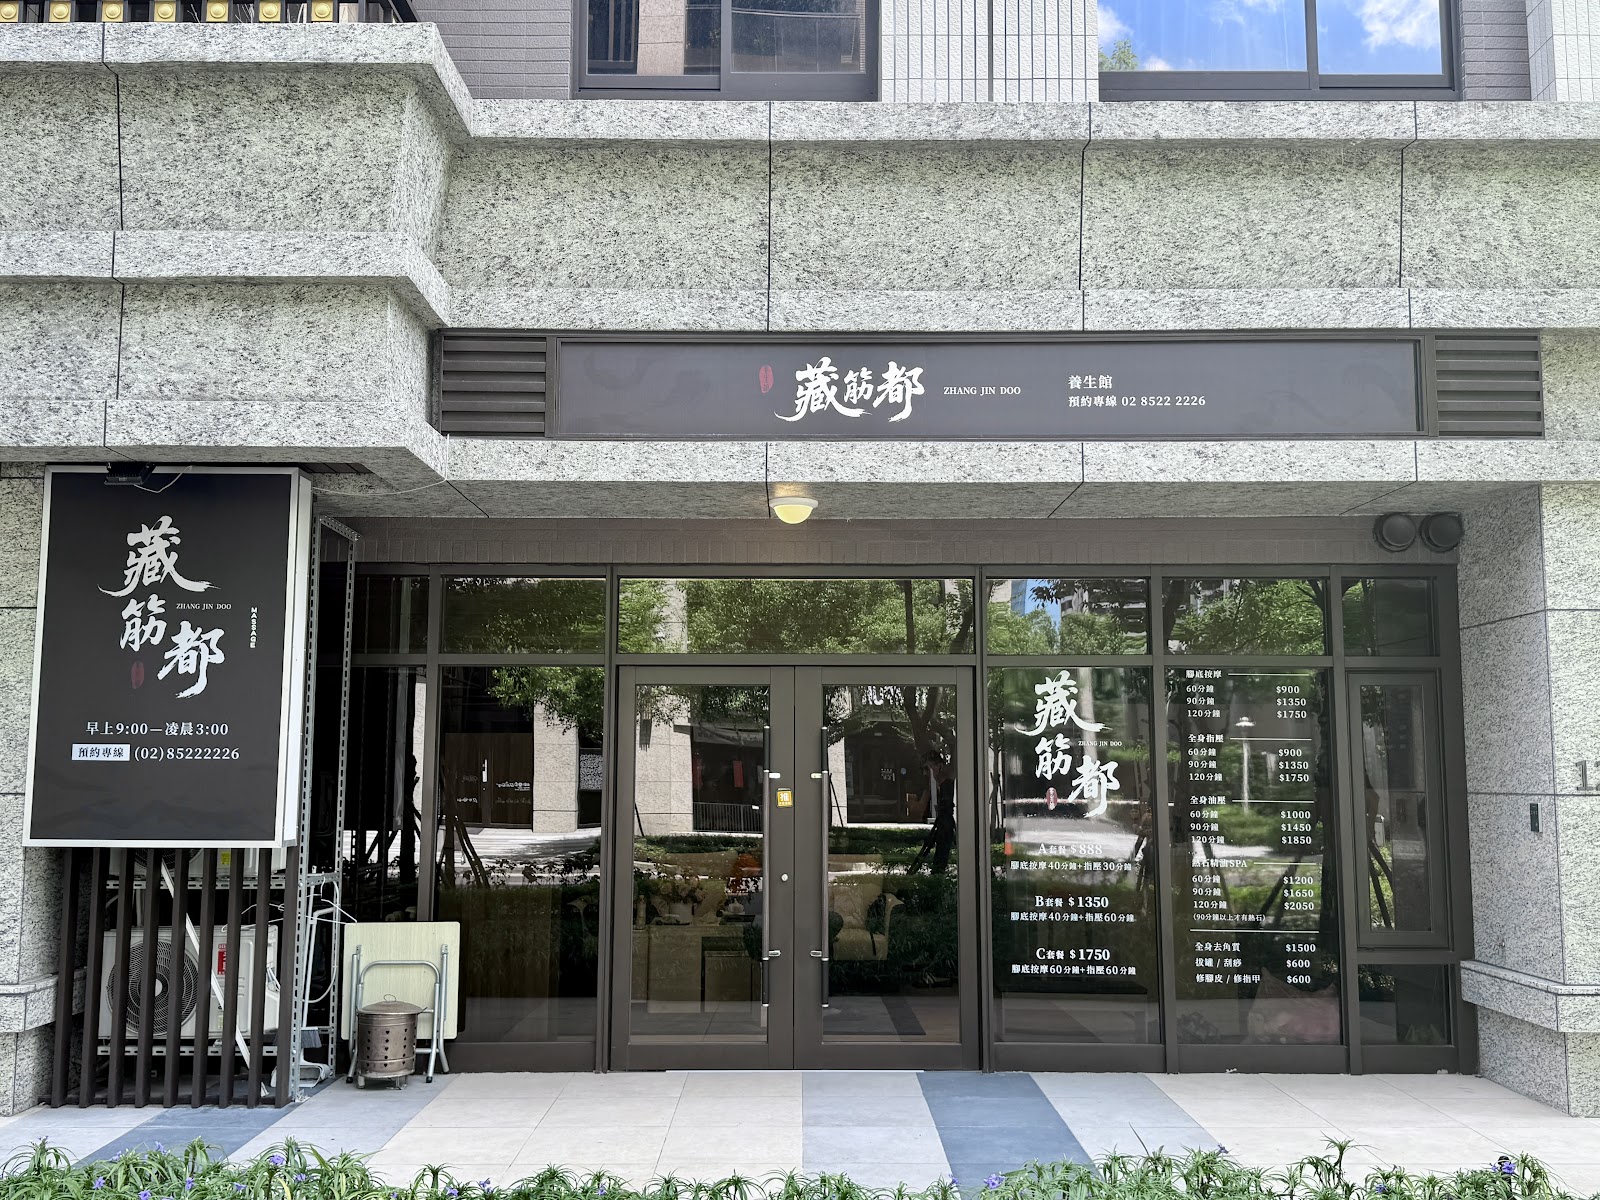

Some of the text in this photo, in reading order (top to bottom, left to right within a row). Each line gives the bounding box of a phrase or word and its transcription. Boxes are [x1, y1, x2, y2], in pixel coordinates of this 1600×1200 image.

[1068, 374, 1113, 390] 養生館
[774, 356, 925, 423] 藏筋都
[943, 386, 1021, 395] ZHANG JIN DOO
[1068, 395, 1206, 408] 預約專線 02 8522 2226
[250, 607, 258, 648] MASSAGE
[1186, 684, 1300, 694] 60分鐘 $900
[1186, 697, 1306, 707] 90分鐘 $1350
[1277, 710, 1307, 719] $1750
[1188, 734, 1224, 743] 全身指壓
[78, 747, 240, 761] 預約專線 (02)85222226
[1187, 748, 1302, 757] 60分鐘 $900
[1188, 760, 1309, 770] 90分鐘 $1350
[1189, 773, 1309, 782] 120分鐘 $1750
[1189, 796, 1226, 805] 全身油壓
[1190, 810, 1311, 819] 60分鐘 $1000
[1190, 823, 1311, 832] 90分鐘 $1450
[1191, 835, 1311, 844] 120分鐘 $1850
[1192, 875, 1313, 885] 60分鐘 $1200
[1193, 888, 1314, 898] 90分鐘 $1650
[1035, 896, 1063, 907] B套餐
[1193, 901, 1314, 910] 120分鐘 $2050
[1194, 942, 1316, 952] 全身去角質 $1500
[1036, 948, 1065, 960] C套餐
[1286, 960, 1310, 968] $600
[1234, 974, 1261, 984] 修指甲
[1287, 975, 1311, 984] $600
